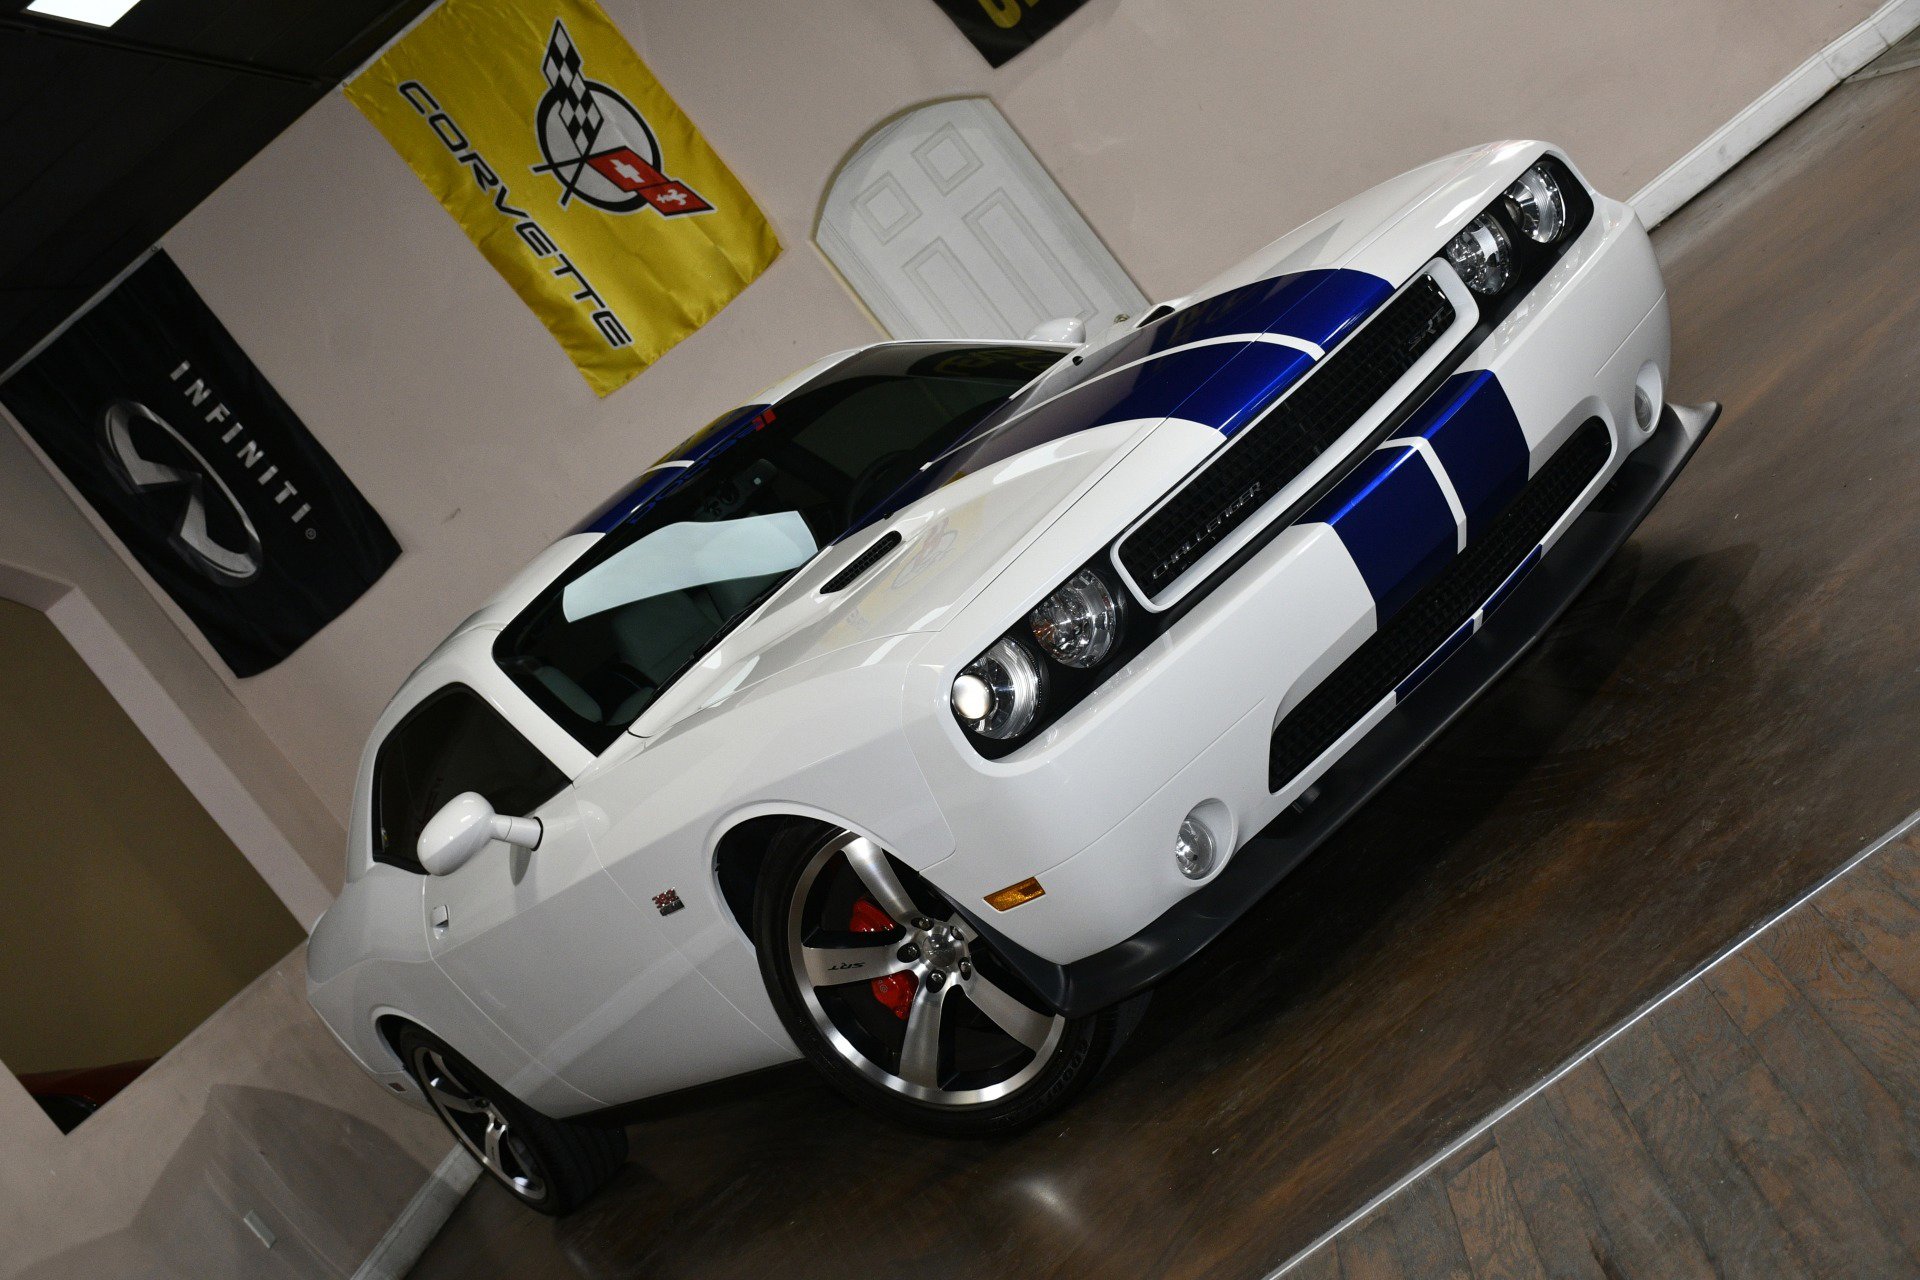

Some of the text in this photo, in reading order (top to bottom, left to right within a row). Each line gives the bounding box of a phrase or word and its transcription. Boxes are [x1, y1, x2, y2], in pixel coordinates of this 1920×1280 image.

[399, 80, 633, 349] CORVETTE
[170, 360, 312, 523] INFINITI
[827, 961, 866, 972] SRT
